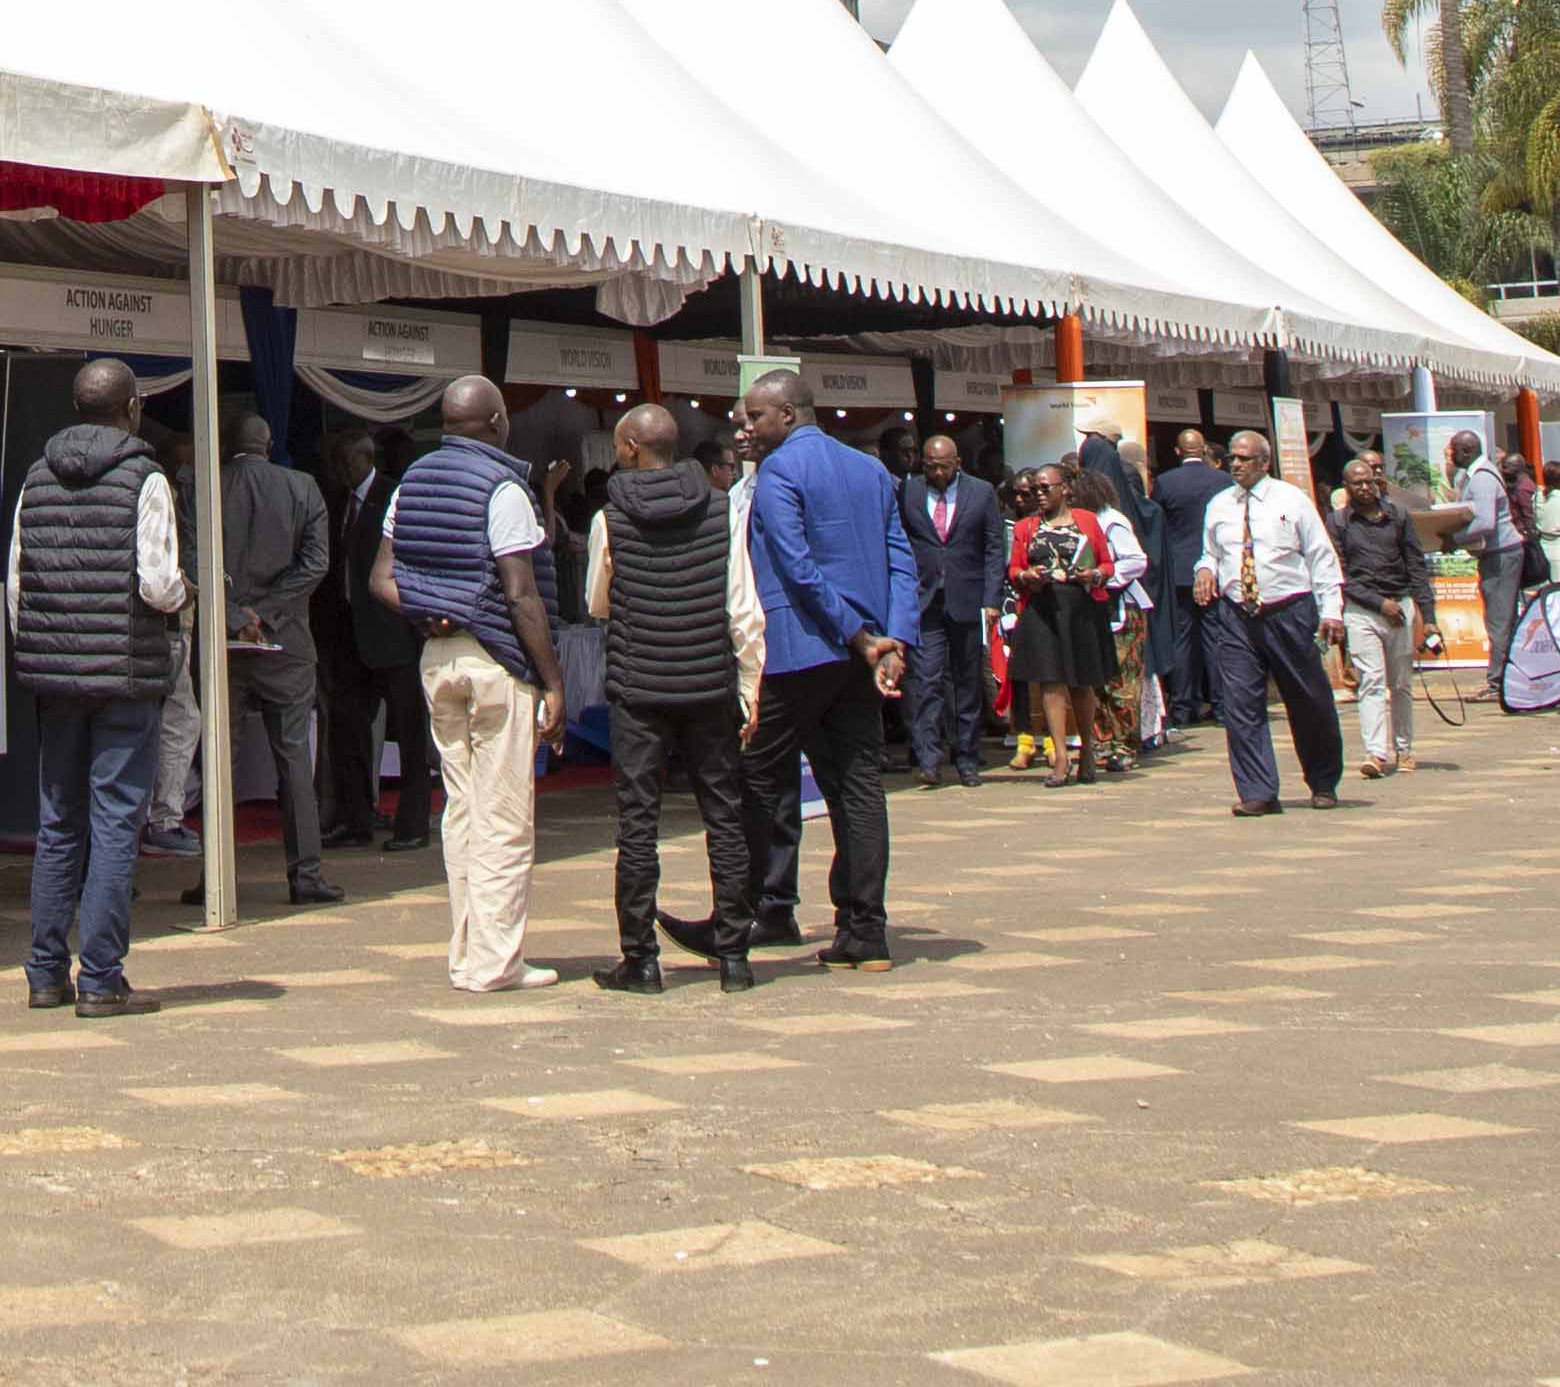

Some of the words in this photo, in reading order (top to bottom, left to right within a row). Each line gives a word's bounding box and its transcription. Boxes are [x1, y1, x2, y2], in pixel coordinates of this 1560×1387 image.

[67, 289, 105, 309] ACTION
[109, 292, 152, 313] AGAINST
[90, 317, 134, 338] HUNGER
[368, 320, 397, 339] ACTION
